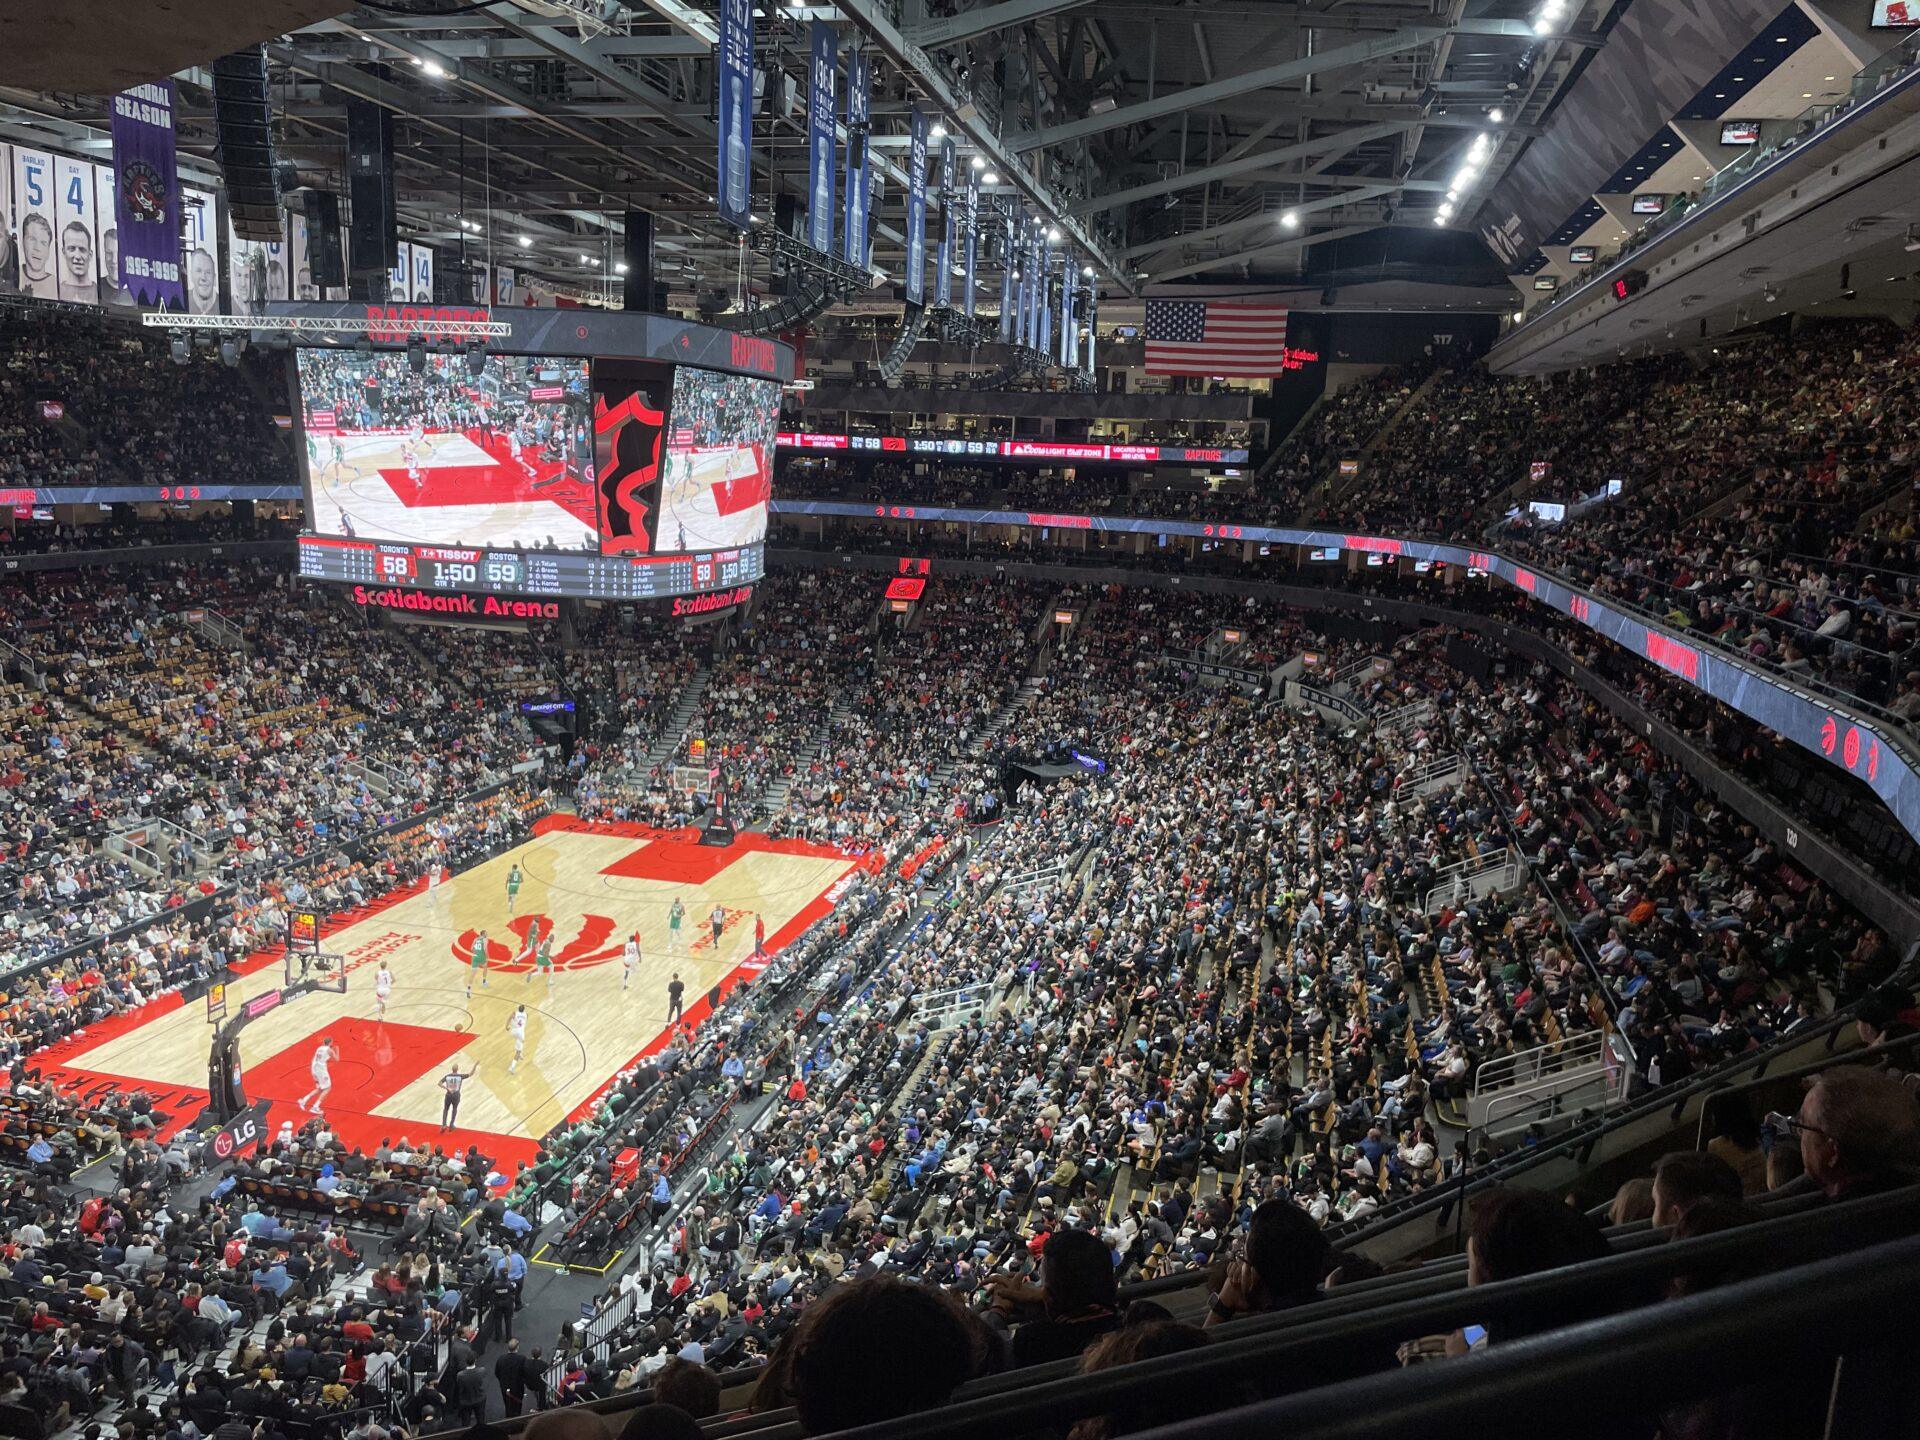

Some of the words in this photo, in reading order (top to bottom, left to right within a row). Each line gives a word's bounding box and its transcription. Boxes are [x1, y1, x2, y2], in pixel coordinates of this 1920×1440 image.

[115, 96, 171, 129] SEASON
[26, 165, 43, 206] 5
[67, 177, 84, 215] 4
[125, 256, 179, 282] 1995-1996
[416, 257, 430, 287] 14
[1433, 334, 1453, 345] 317
[730, 333, 775, 373] RAPTORS
[865, 437, 880, 449] 58
[913, 440, 935, 451] 1:50
[967, 442, 983, 453] 59
[1046, 447, 1066, 455] LIGHT
[1184, 449, 1222, 460] RAPTORS
[380, 545, 408, 554] TORONTO
[436, 550, 477, 560] TISSOT
[489, 552, 518, 561] BOSTON
[6, 560, 18, 569] 109
[383, 556, 408, 575] 58
[434, 562, 476, 582] 1:50
[488, 564, 516, 581] 59
[697, 564, 711, 581] 58
[722, 562, 738, 580] 1:50
[740, 558, 749, 574] 59
[354, 585, 476, 614] Scotiabank
[484, 596, 559, 618] Arena
[671, 589, 734, 616] Scotiabank
[1202, 665, 1214, 674] IBM
[1218, 668, 1230, 677] IBM
[1234, 671, 1244, 681] IBM
[530, 703, 552, 712] JACKPOT
[564, 824, 684, 842] RAPTORS
[1786, 828, 1798, 848] 120
[346, 931, 402, 956] Arena
[285, 994, 296, 1003] Uber
[296, 990, 307, 999] Eats
[42, 1072, 209, 1109] APTORS
[233, 1119, 257, 1146] LG
